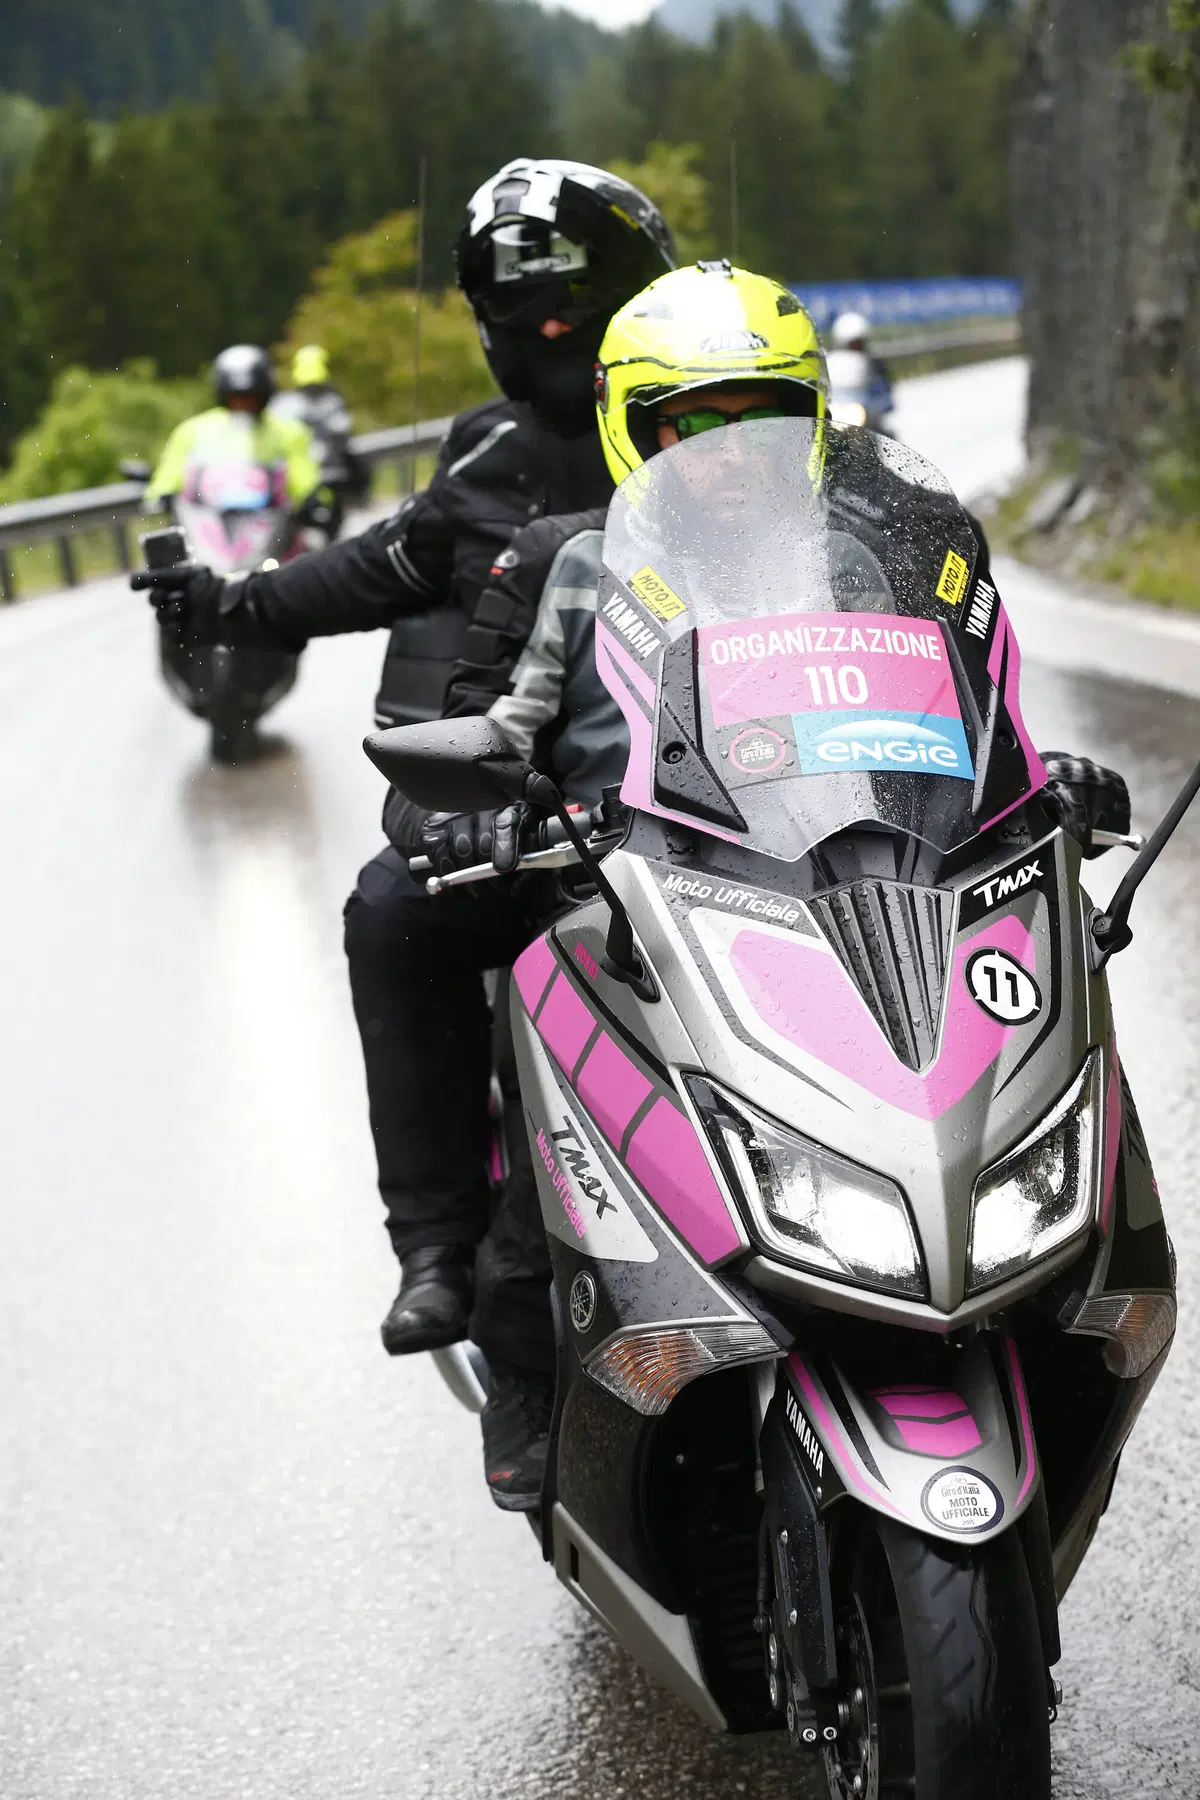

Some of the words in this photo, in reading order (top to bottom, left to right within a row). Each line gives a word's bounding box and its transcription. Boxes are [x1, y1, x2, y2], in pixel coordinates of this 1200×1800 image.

[637, 574, 681, 613] MOTO.IT
[943, 555, 963, 600] MOTO.IT
[601, 591, 661, 659] YAMAHA
[965, 578, 996, 640] YAMAHA
[711, 627, 943, 666] ORGANIZZAZIONE
[804, 665, 869, 706] 110
[662, 873, 713, 899] Moto
[714, 886, 801, 923] Ufficiale
[983, 965, 1020, 1008] 11
[535, 1127, 555, 1173] Moto
[552, 1167, 587, 1239] Ufficiale
[786, 1388, 824, 1478] YAMAHA
[941, 1488, 956, 1498] Giro
[942, 1507, 990, 1520] UFFICIALE
[949, 1497, 978, 1508] MOTO
